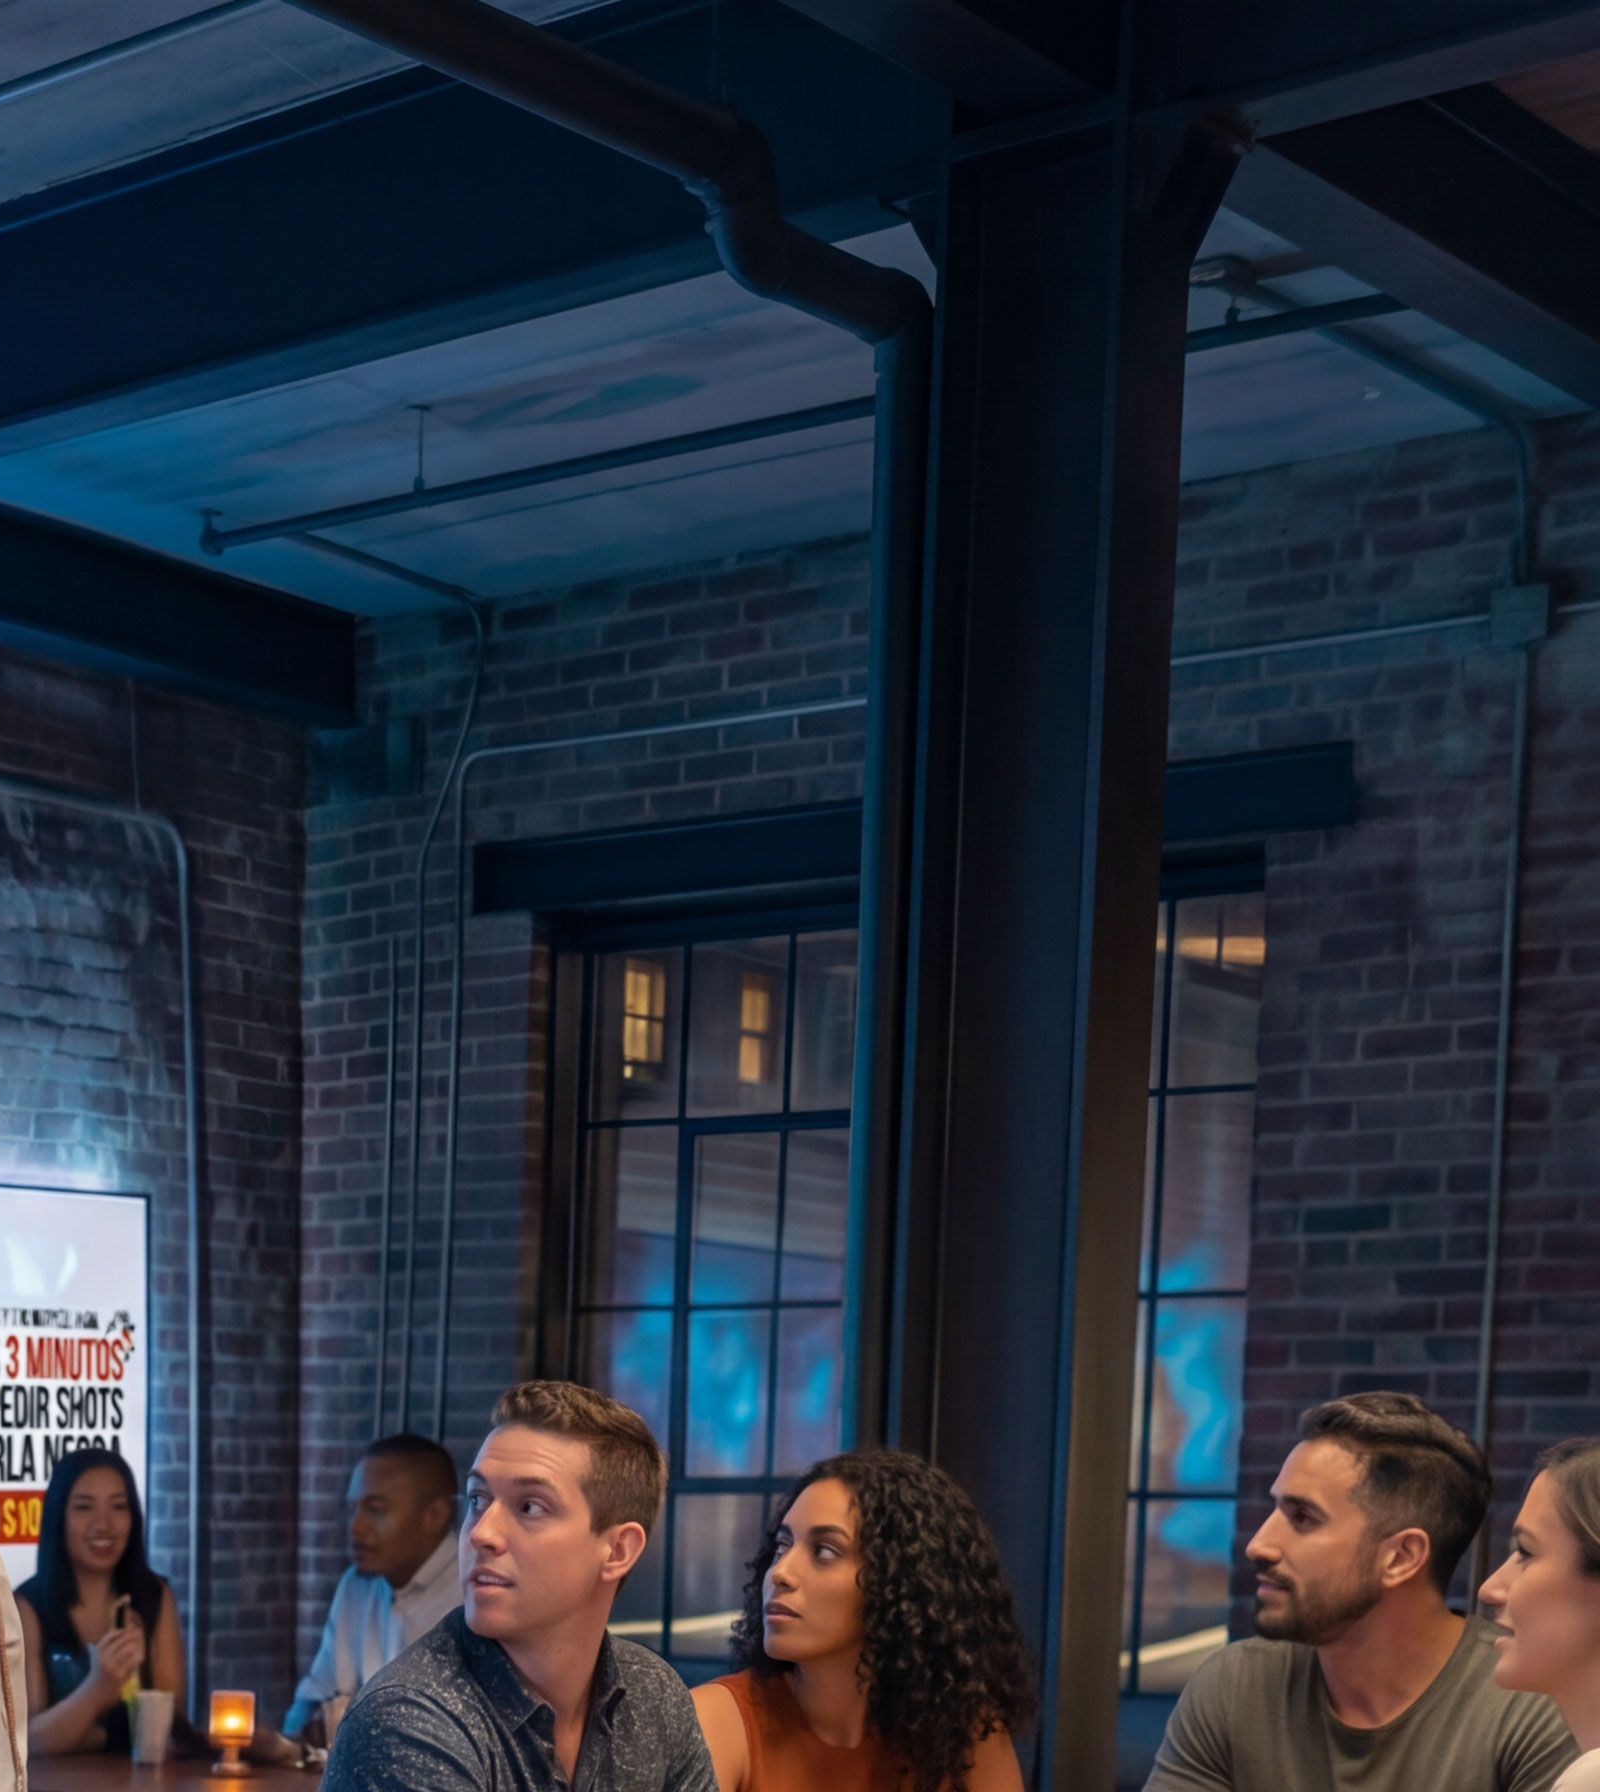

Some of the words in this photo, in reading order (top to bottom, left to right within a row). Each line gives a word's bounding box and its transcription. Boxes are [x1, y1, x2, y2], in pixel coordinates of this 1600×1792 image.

[5, 1335, 20, 1379] 3
[26, 1336, 124, 1381] MINUTOS
[56, 1386, 124, 1430] SHOTS
